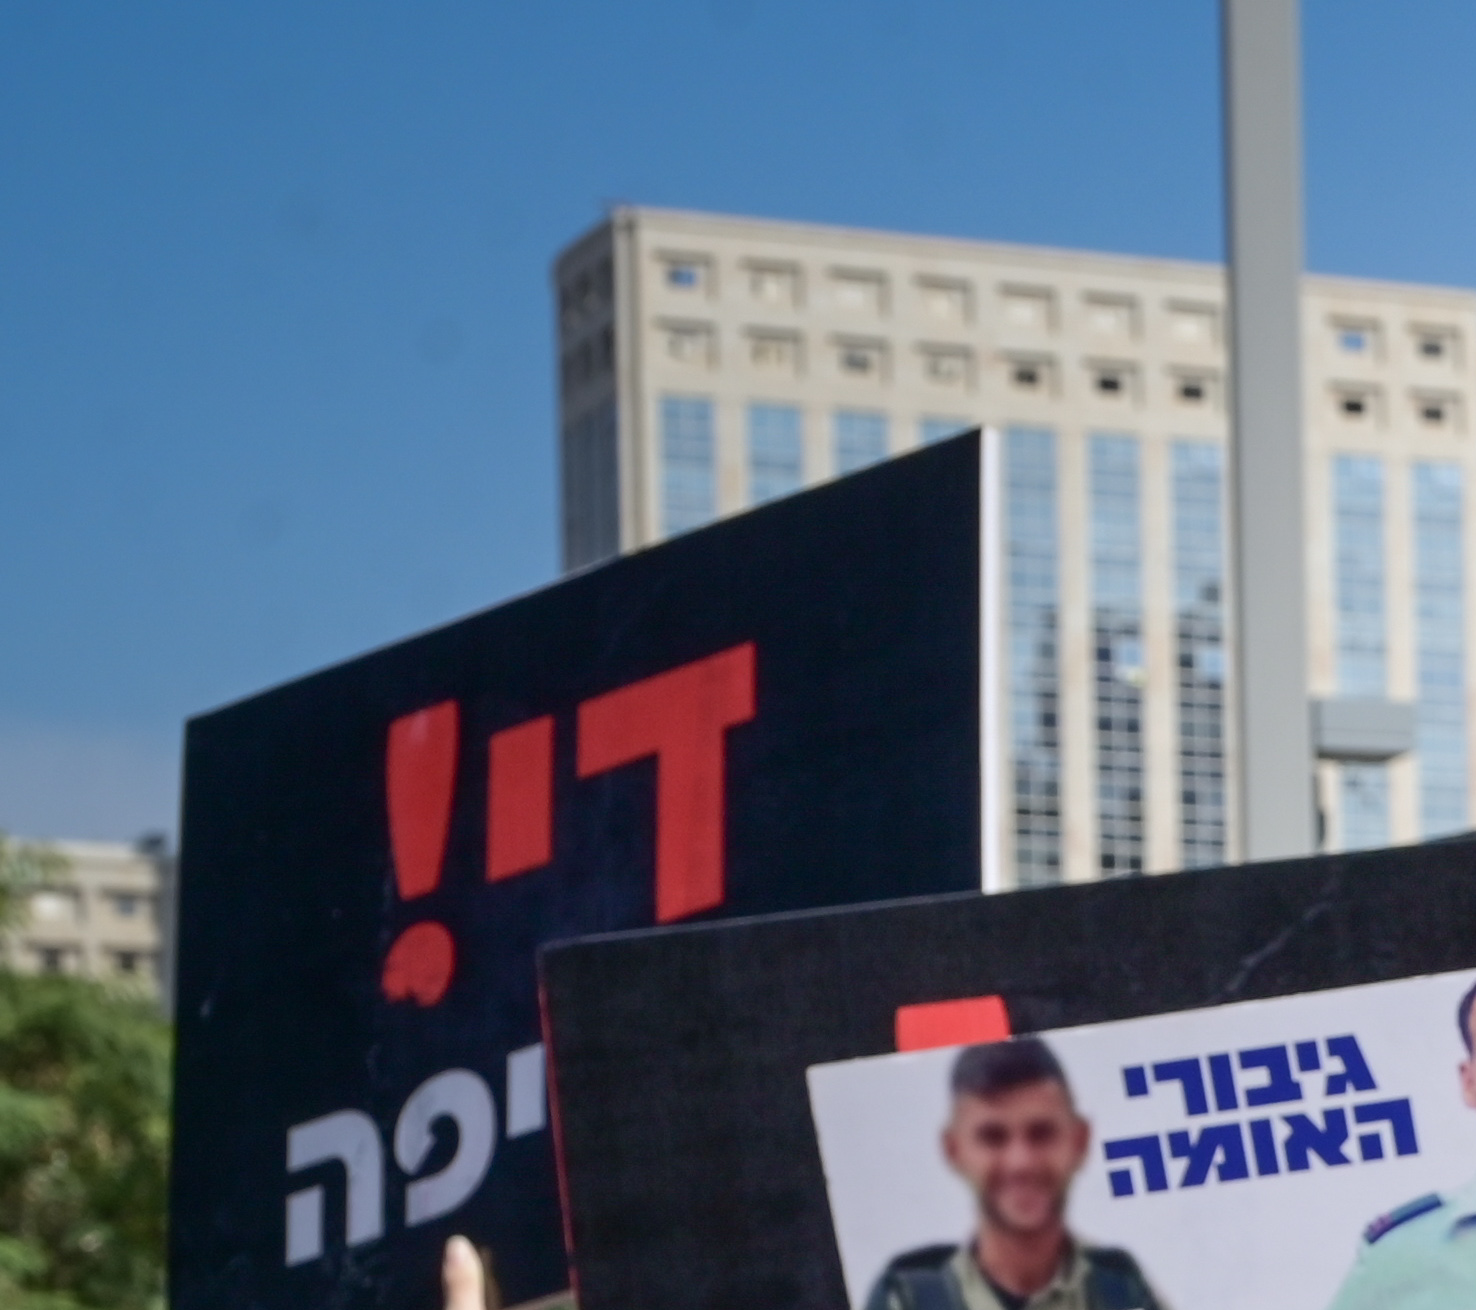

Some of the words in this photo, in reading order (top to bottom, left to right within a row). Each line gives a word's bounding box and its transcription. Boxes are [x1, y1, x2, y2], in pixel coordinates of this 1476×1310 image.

[384, 645, 754, 1003] די!
[1123, 1034, 1377, 1116] גיבורי
[1104, 1097, 1419, 1197] האומה
